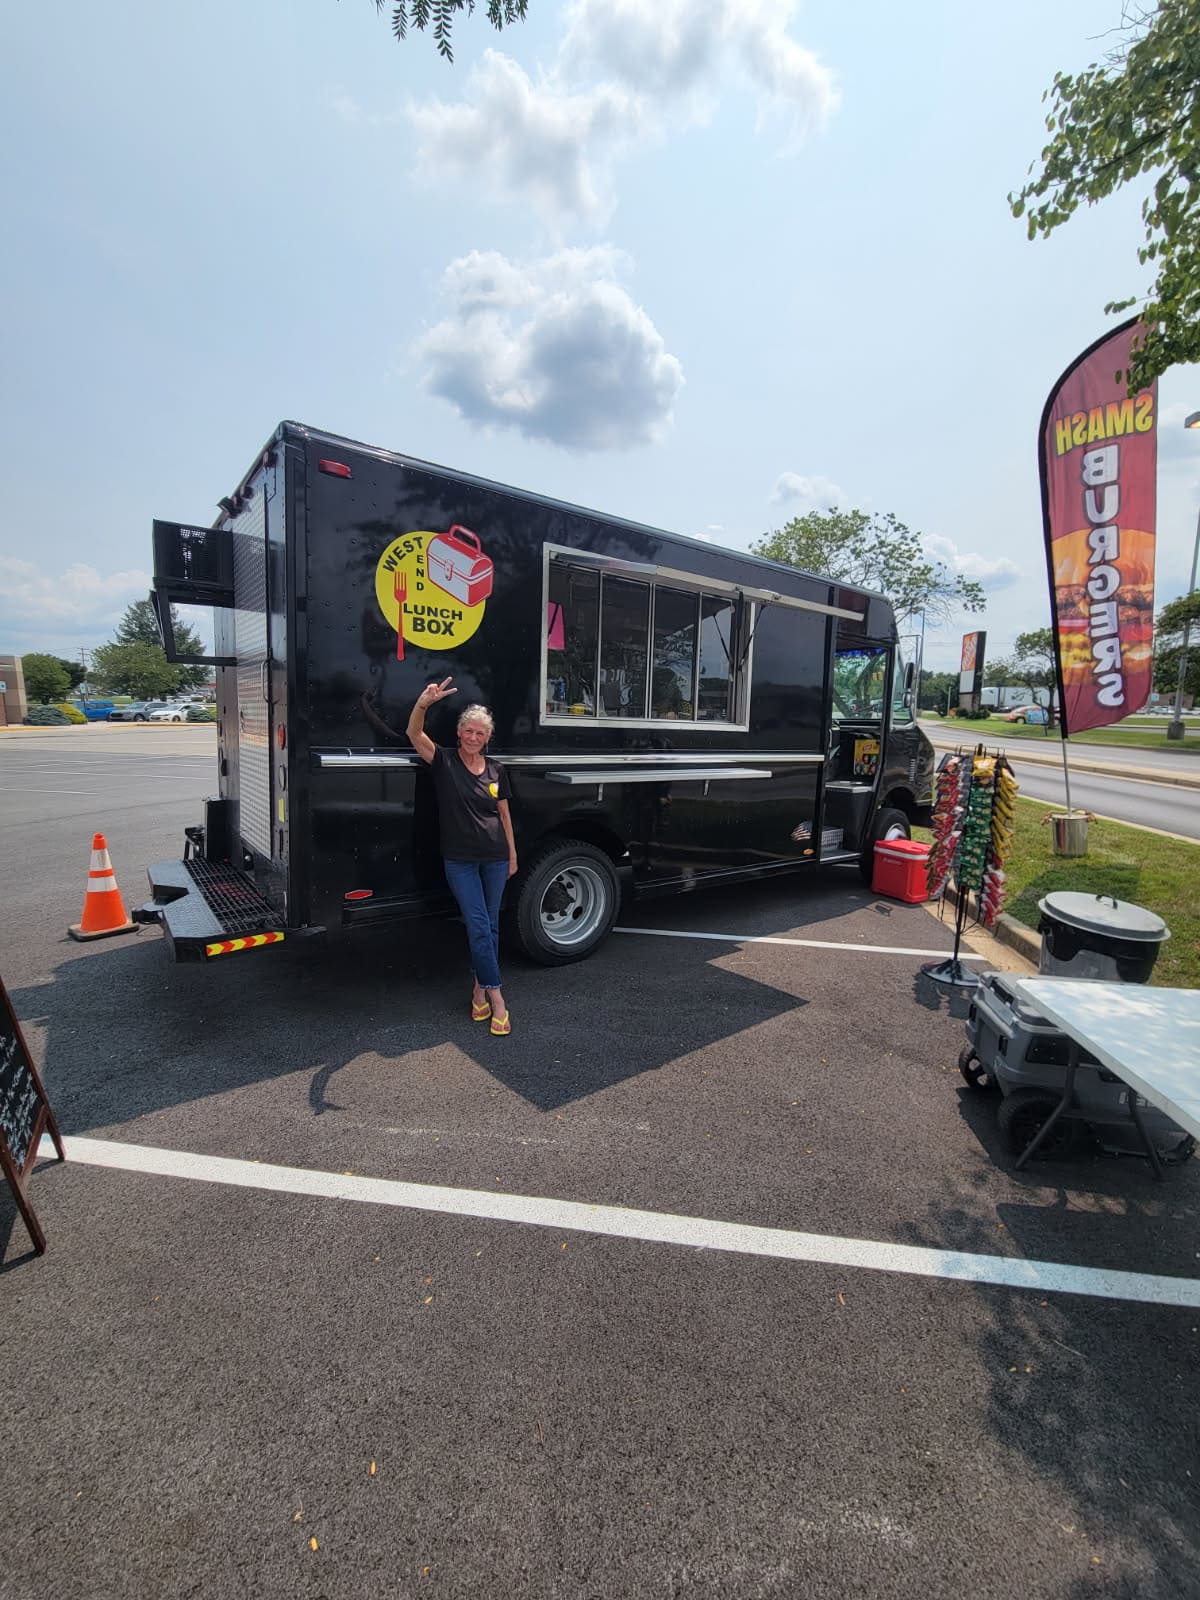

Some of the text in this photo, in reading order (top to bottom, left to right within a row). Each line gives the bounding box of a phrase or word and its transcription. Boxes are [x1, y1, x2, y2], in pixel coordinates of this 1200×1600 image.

[383, 536, 423, 573] WEST
[416, 555, 424, 591] END
[403, 603, 463, 621] LUNCH
[412, 617, 455, 636] BOX
